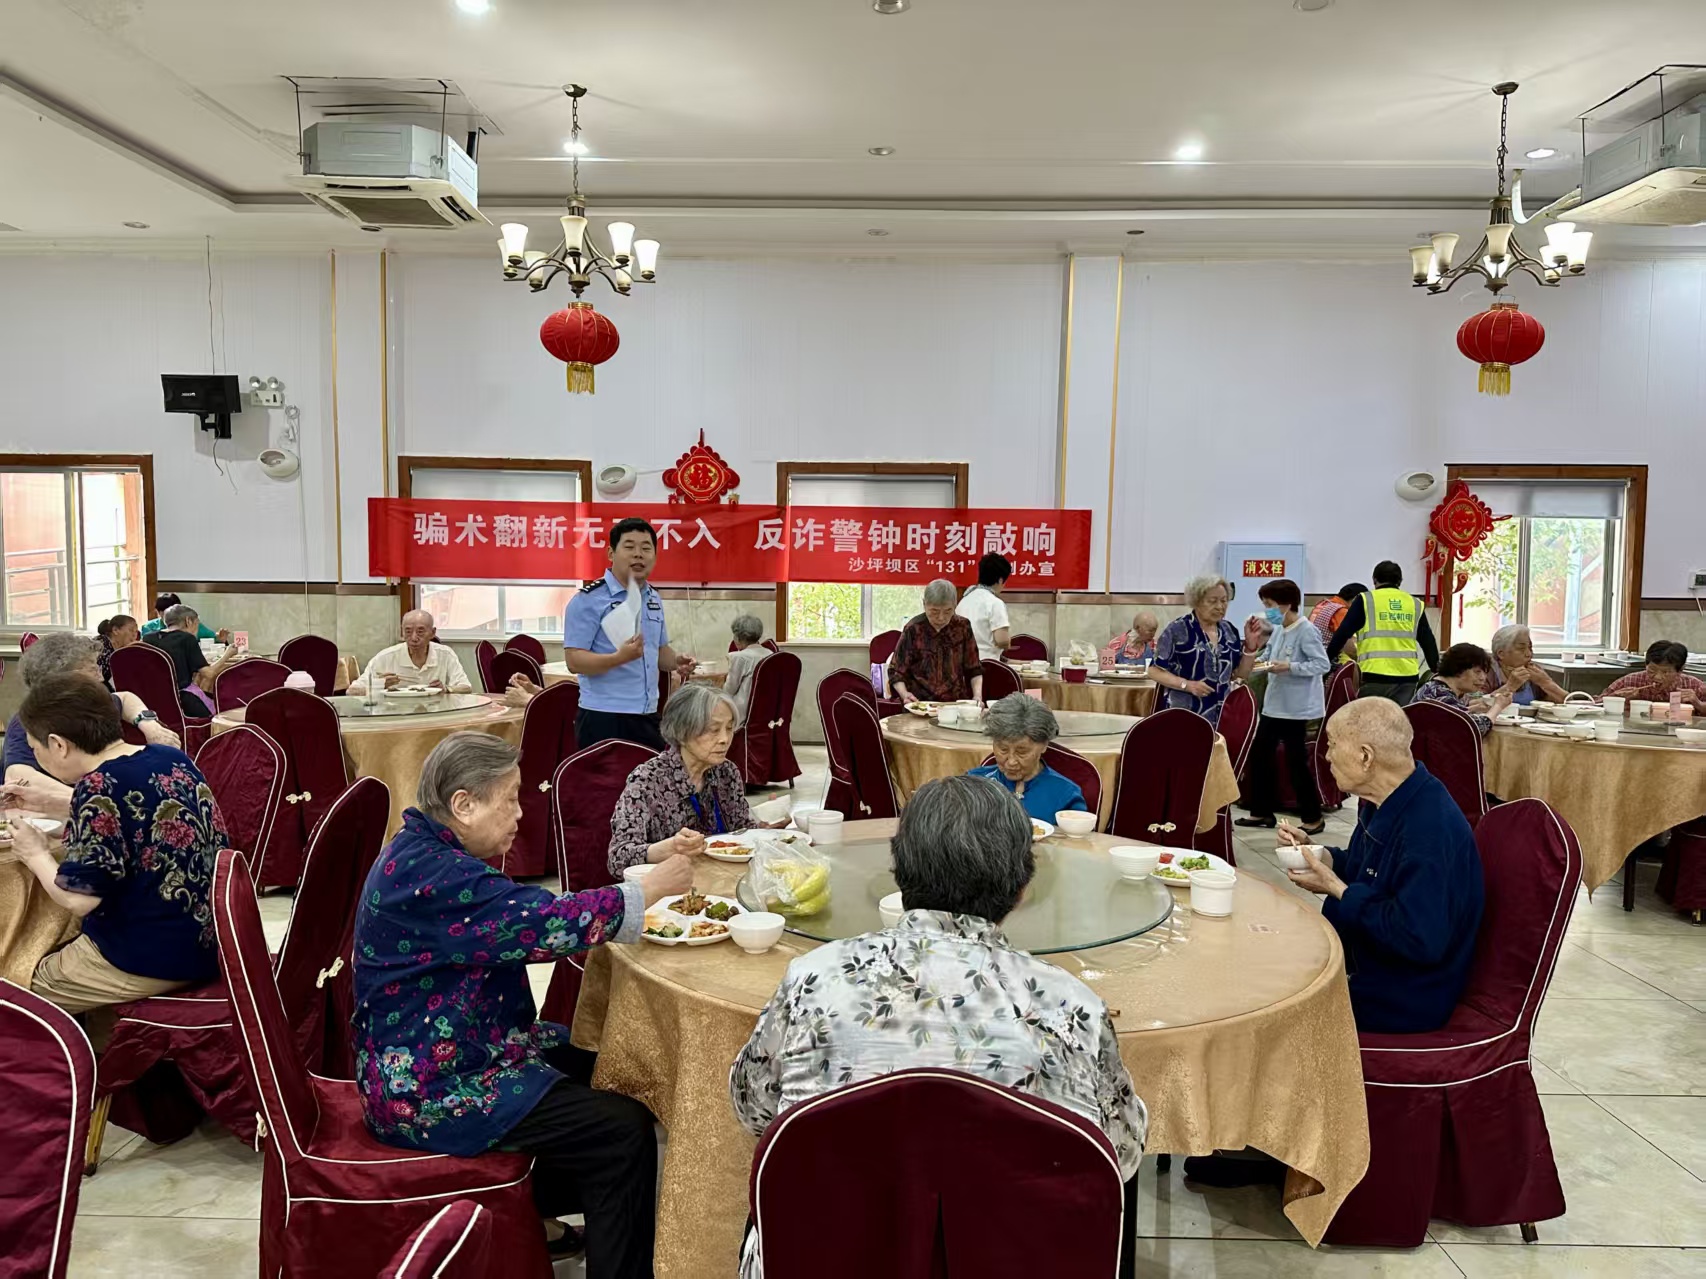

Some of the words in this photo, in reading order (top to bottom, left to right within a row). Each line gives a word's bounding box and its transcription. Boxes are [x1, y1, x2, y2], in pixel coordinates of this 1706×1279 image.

[413, 512, 721, 550] 骗术翻新无不入
[754, 518, 1056, 557] 反诈警钟时刻敲响
[848, 557, 1055, 576] 沙坪坝区“131”办宣
[1245, 561, 1283, 574] 消火栓
[1102, 657, 1114, 665] 25
